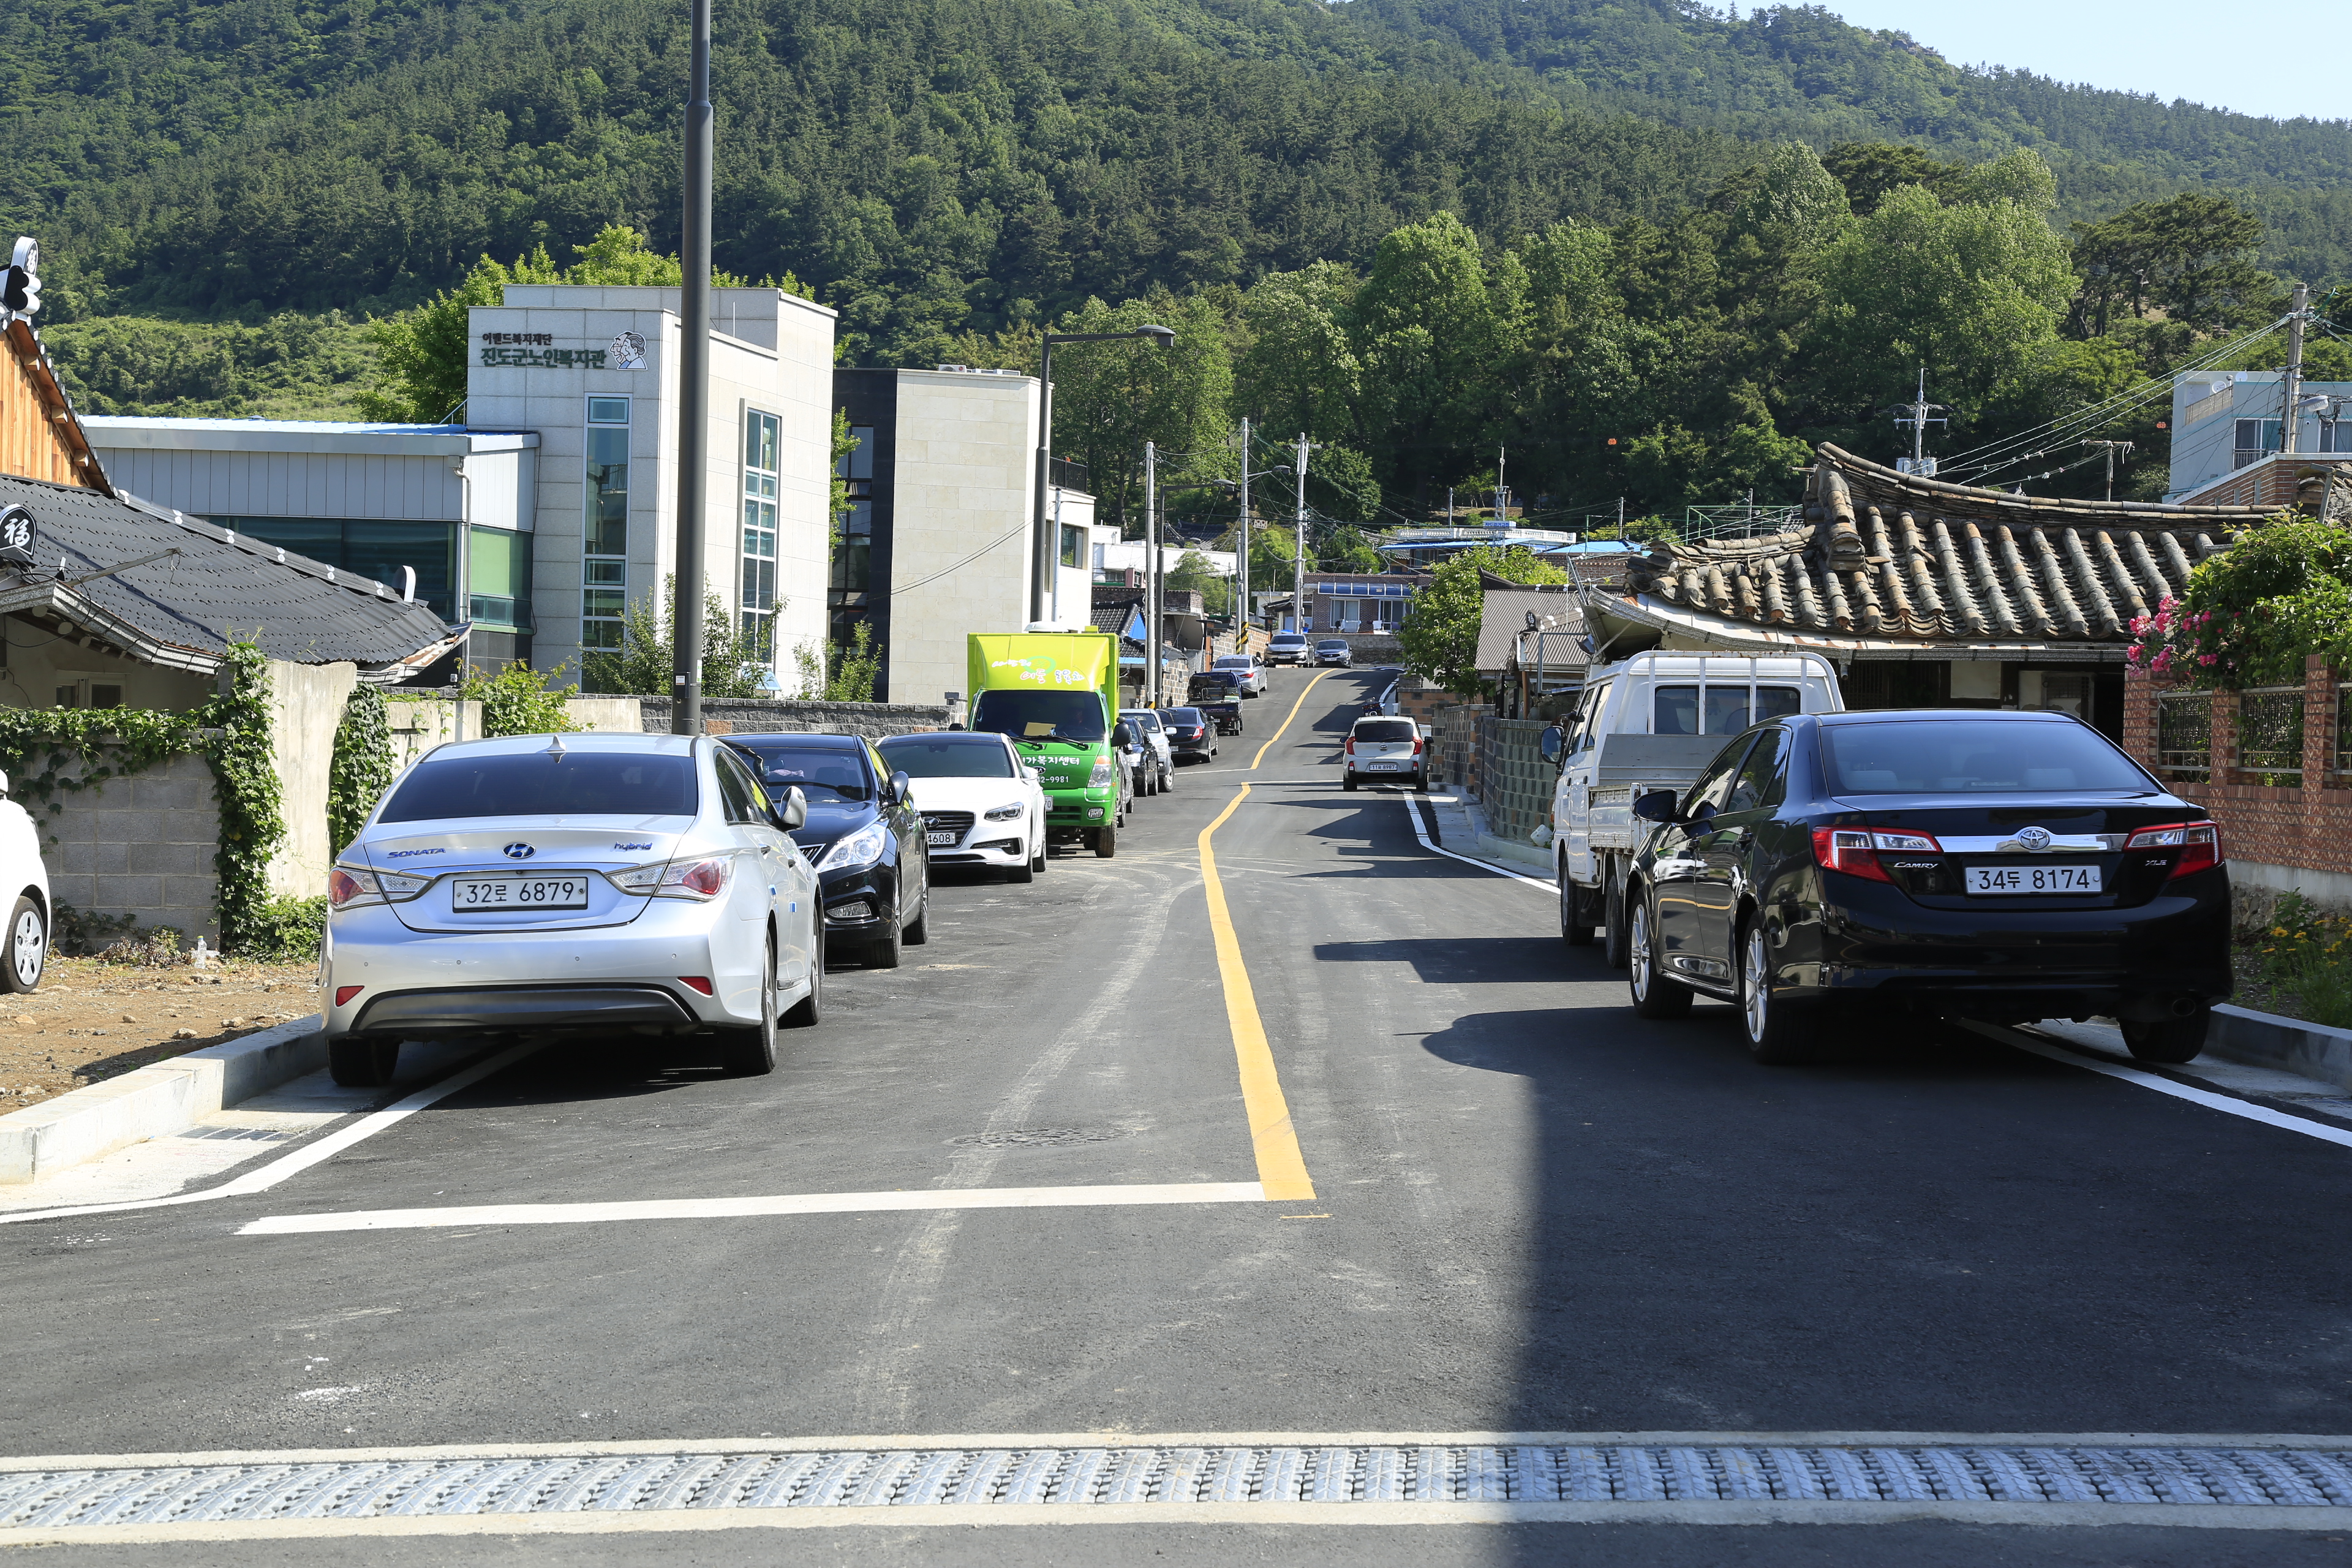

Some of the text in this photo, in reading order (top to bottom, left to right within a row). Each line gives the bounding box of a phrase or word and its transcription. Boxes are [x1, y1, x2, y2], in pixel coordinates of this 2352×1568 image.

[482, 333, 552, 345] 이랜드복지재단
[481, 347, 606, 369] 진도군노인복지관
[4, 518, 31, 547] 福
[1020, 668, 1084, 684] 이동 목욕차
[1022, 755, 1080, 766] 가복지센터
[386, 848, 446, 858] SONATA
[614, 841, 654, 851] hybrid
[1978, 869, 2090, 889] 34두 8174
[467, 882, 574, 903] 32로 6879
